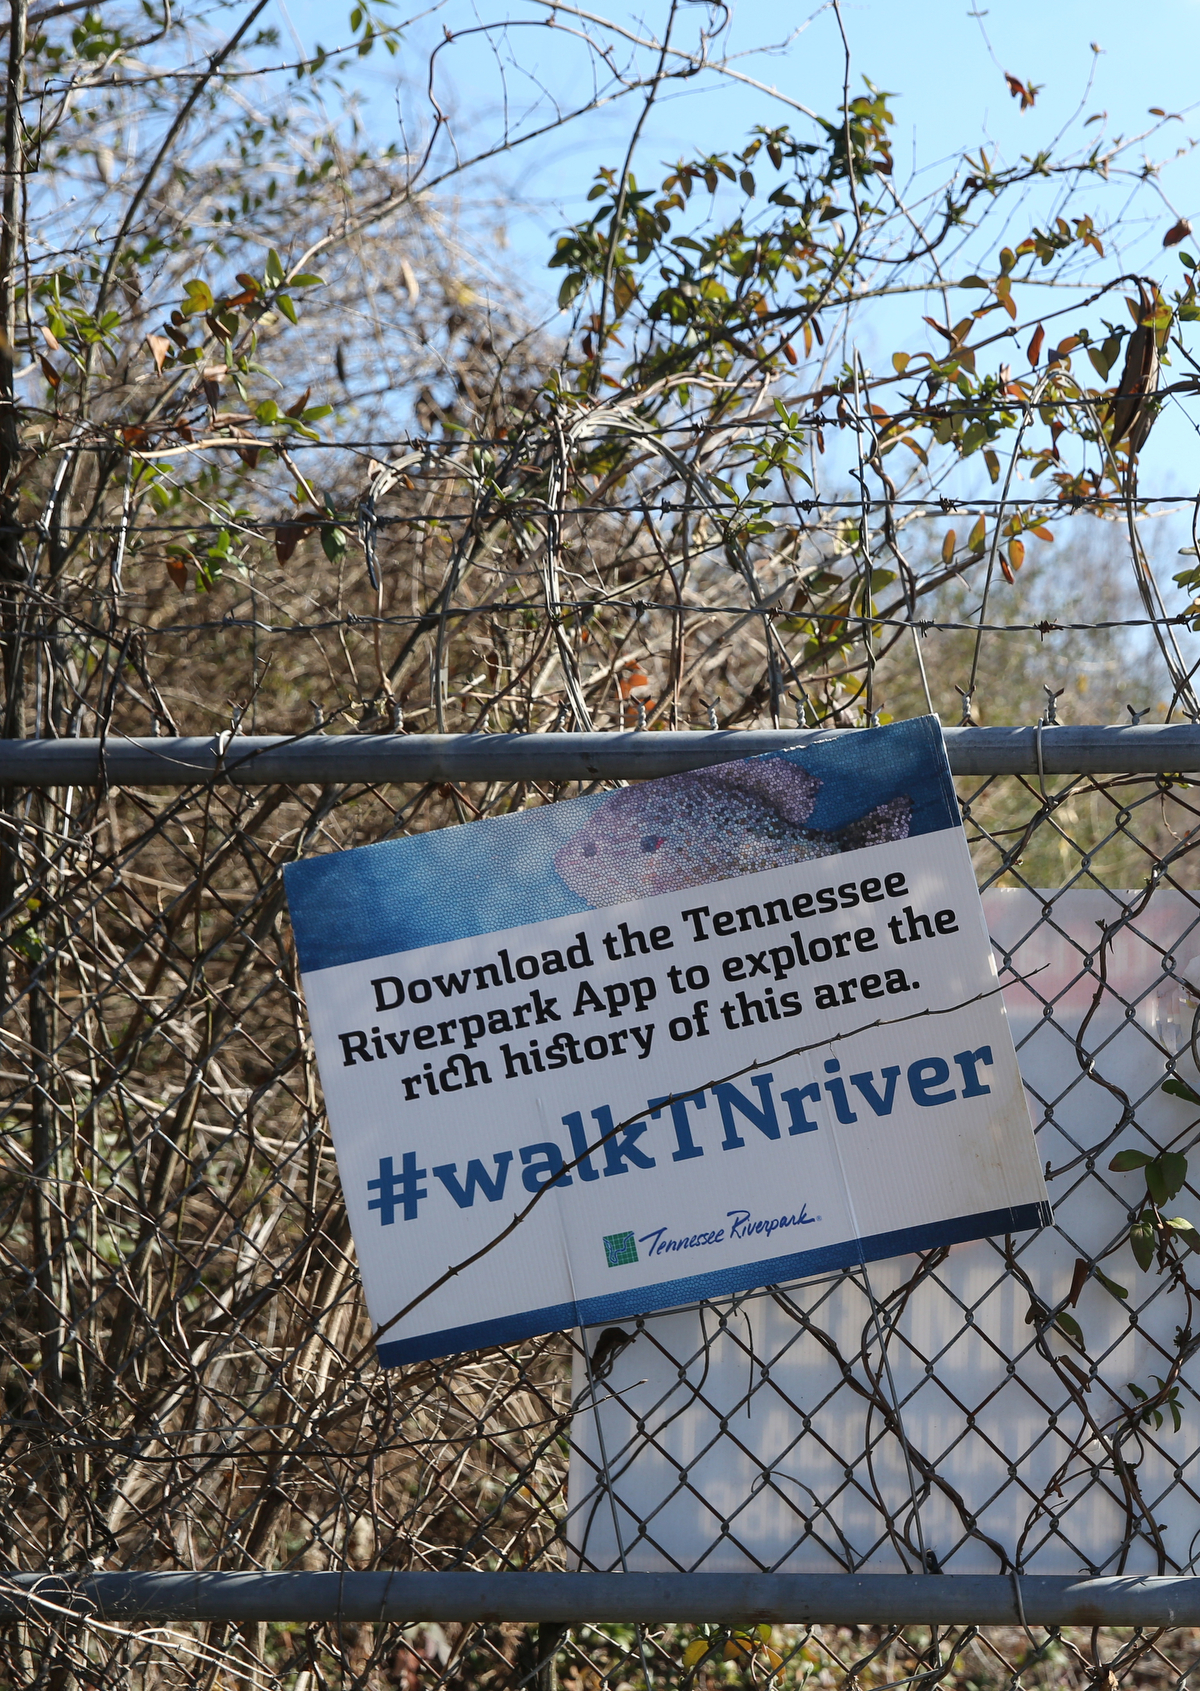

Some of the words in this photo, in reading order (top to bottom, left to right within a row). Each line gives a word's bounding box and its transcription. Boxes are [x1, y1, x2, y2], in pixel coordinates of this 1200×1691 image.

[338, 989, 562, 1066] Riverpark
[574, 977, 657, 1018] App
[667, 965, 710, 995] to
[722, 928, 879, 981] explore
[888, 906, 960, 944] the
[371, 932, 595, 1012] Download
[602, 922, 675, 960] the
[681, 872, 909, 942] Tennessee
[402, 1053, 492, 1101] rich
[500, 1023, 655, 1079] history
[669, 1000, 710, 1041] of
[720, 987, 803, 1029] this
[814, 968, 921, 1009] area.
[367, 1045, 993, 1226] #walkTNriver
[638, 1227, 725, 1257] Tennessee
